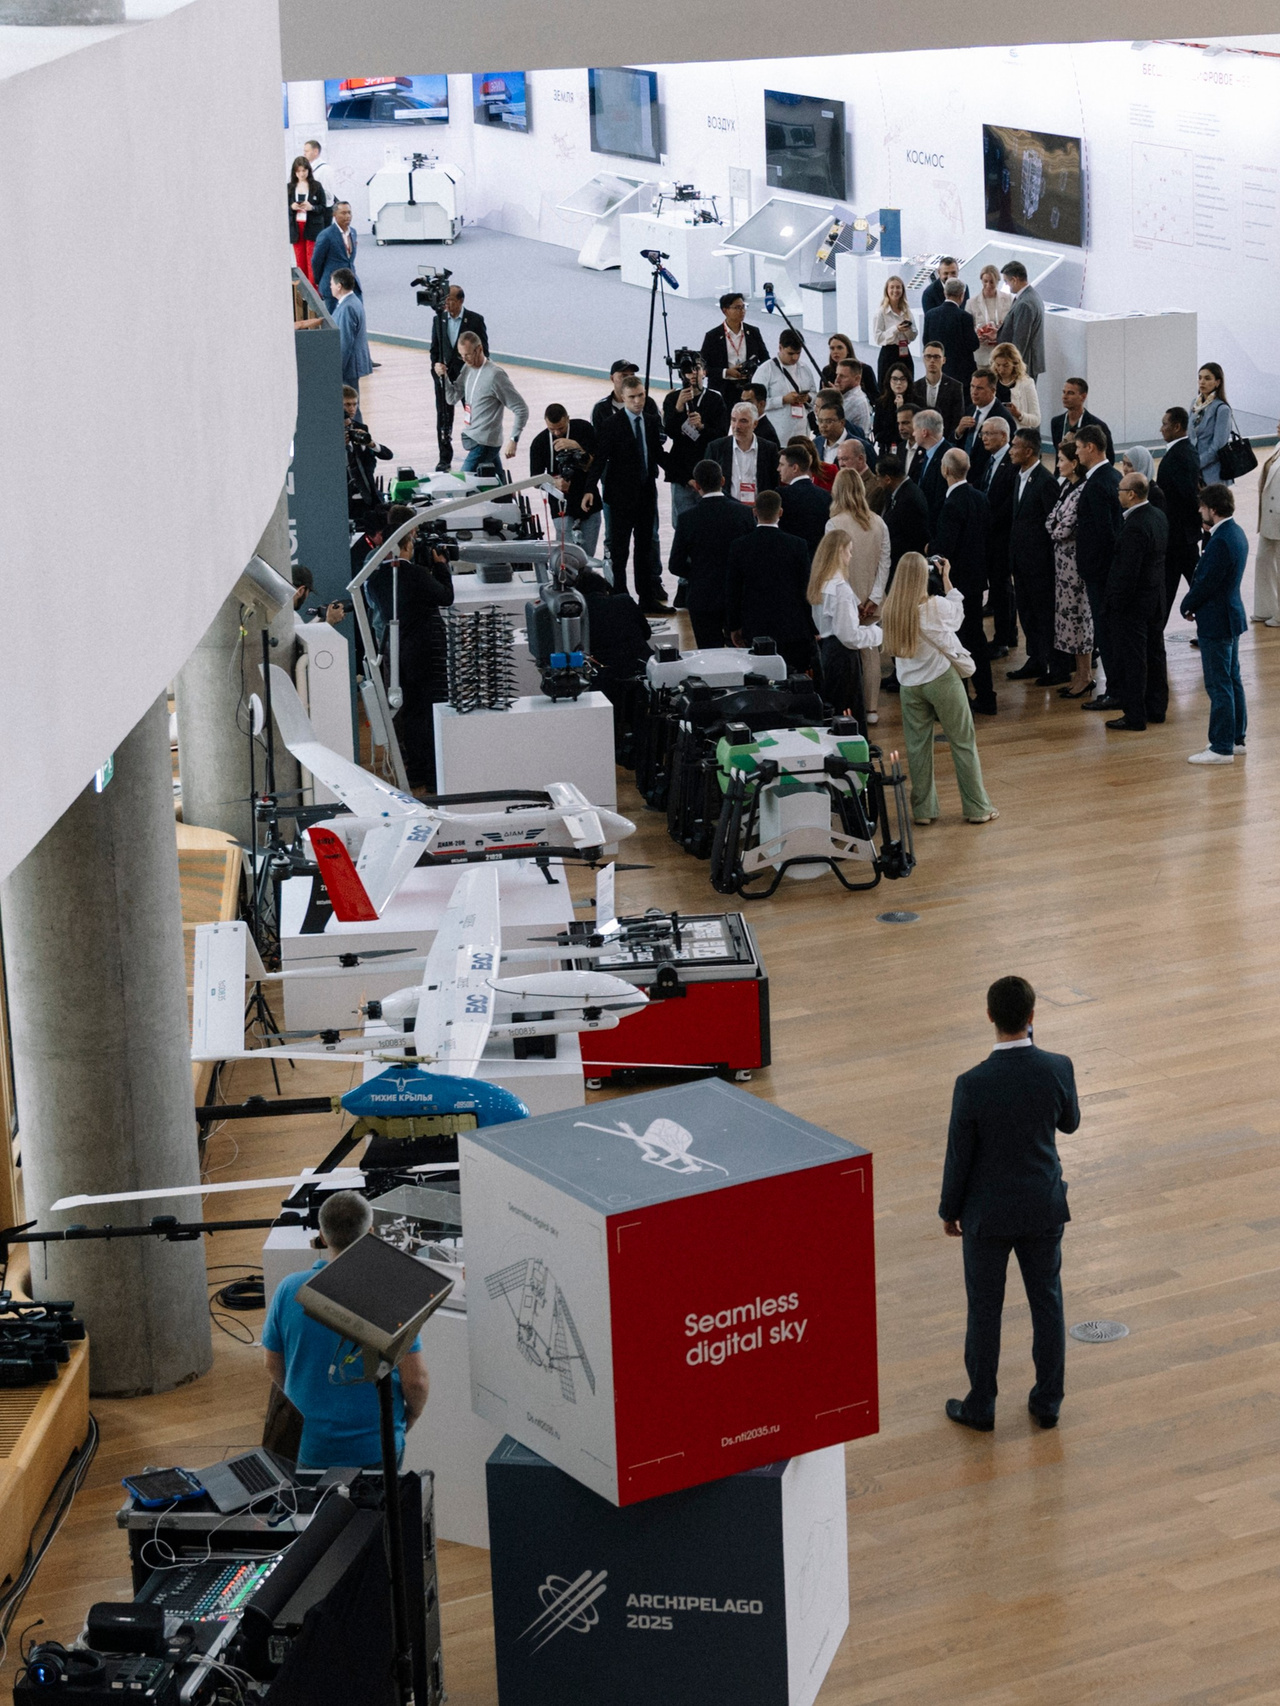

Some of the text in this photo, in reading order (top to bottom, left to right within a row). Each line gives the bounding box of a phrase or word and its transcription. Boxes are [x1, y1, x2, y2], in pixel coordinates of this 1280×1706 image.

[553, 89, 574, 103] ЗЕМЛЯ
[707, 115, 736, 132] ВОЗДУХ
[906, 149, 945, 169] КОСМОС
[370, 1093, 433, 1102] ТИХИЕ КРЫЛЬЯ
[684, 1291, 800, 1338] Seamless
[686, 1318, 808, 1367] digital sky
[720, 1424, 781, 1448] Ds.nti2035.ru
[625, 1592, 764, 1615] ARCHIPELAGO
[626, 1614, 674, 1631] 2025
